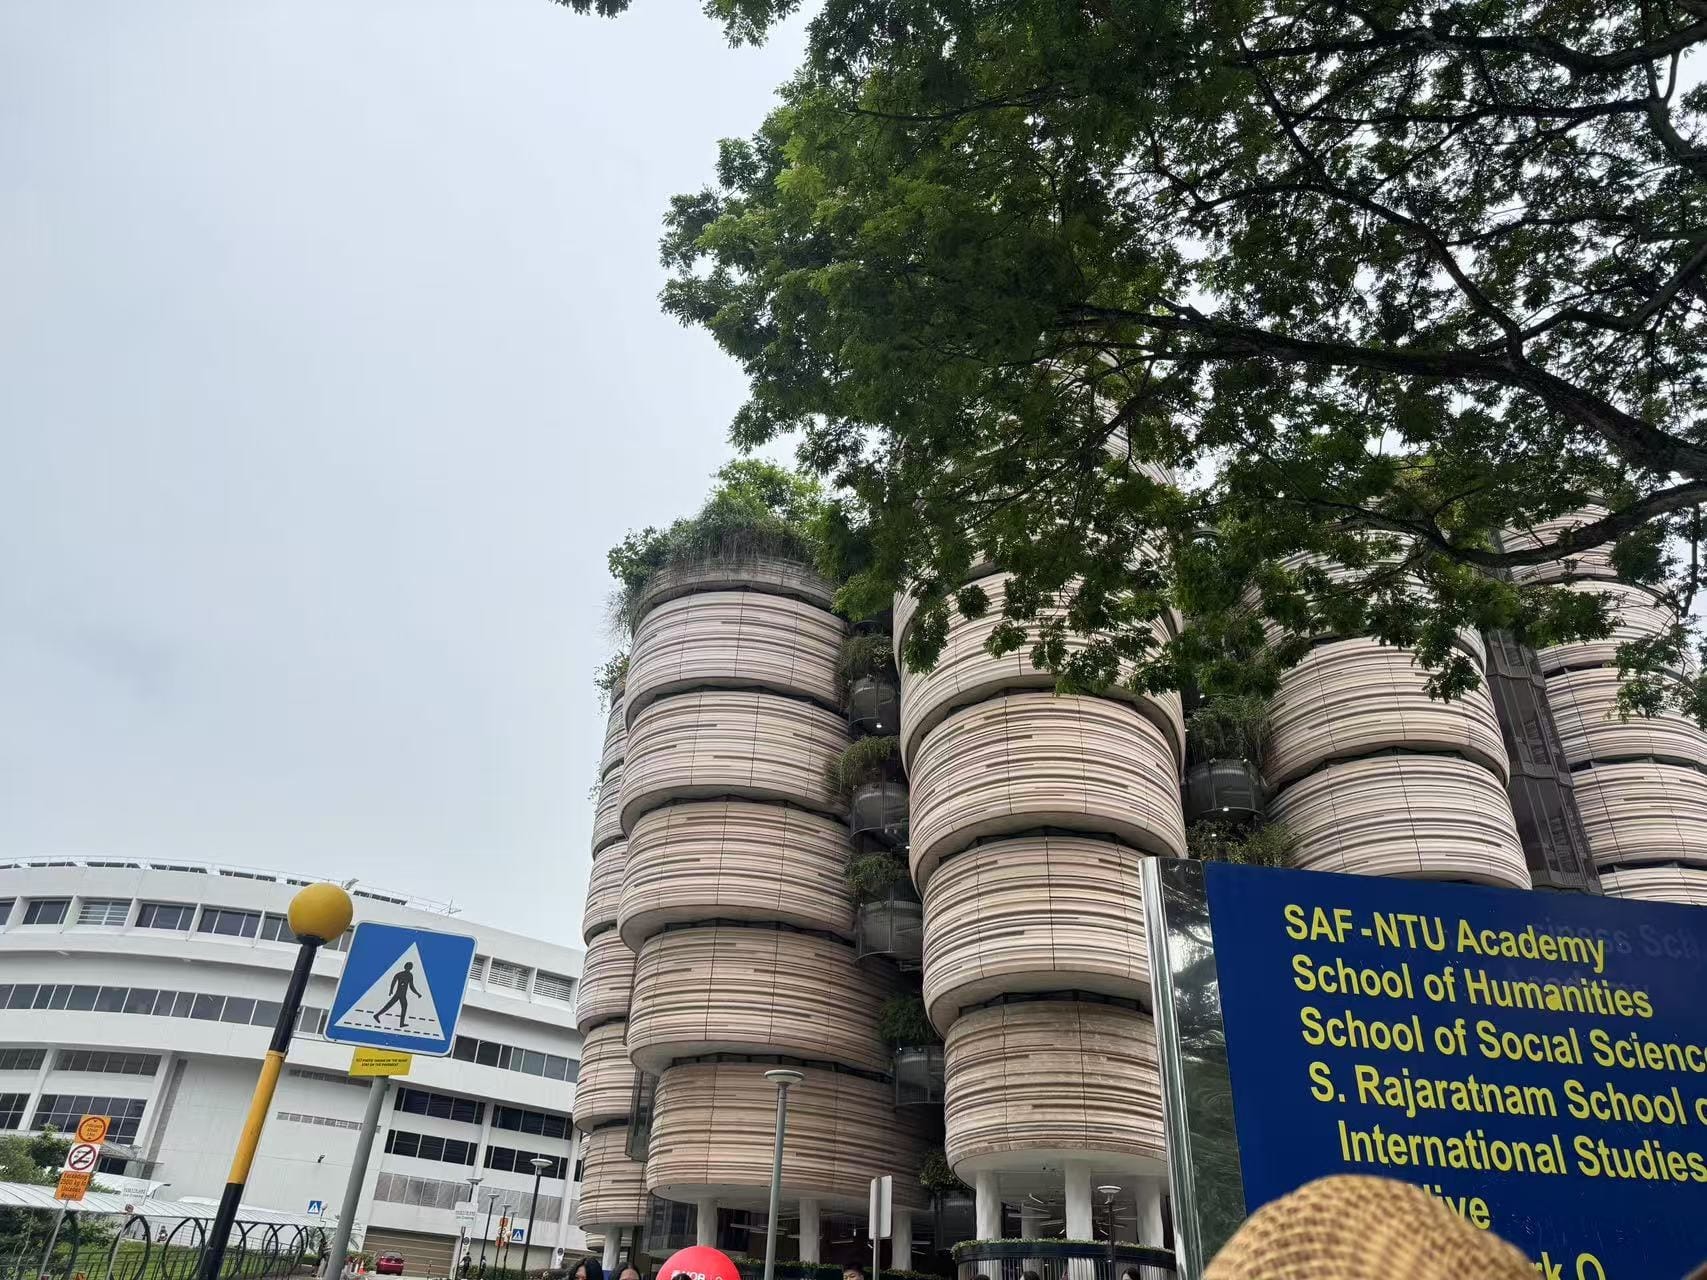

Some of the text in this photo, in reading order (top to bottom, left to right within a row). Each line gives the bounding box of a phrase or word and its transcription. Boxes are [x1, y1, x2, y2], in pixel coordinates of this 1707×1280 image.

[1457, 920, 1605, 974] Academy
[1292, 955, 1414, 999] School
[1424, 967, 1456, 1002] of
[1465, 970, 1654, 1019] Humanities
[1301, 1007, 1707, 1073] School of Social Scienc
[1309, 1061, 1707, 1126] S. Rajaratnam School o
[1338, 1121, 1707, 1183] International Studies
